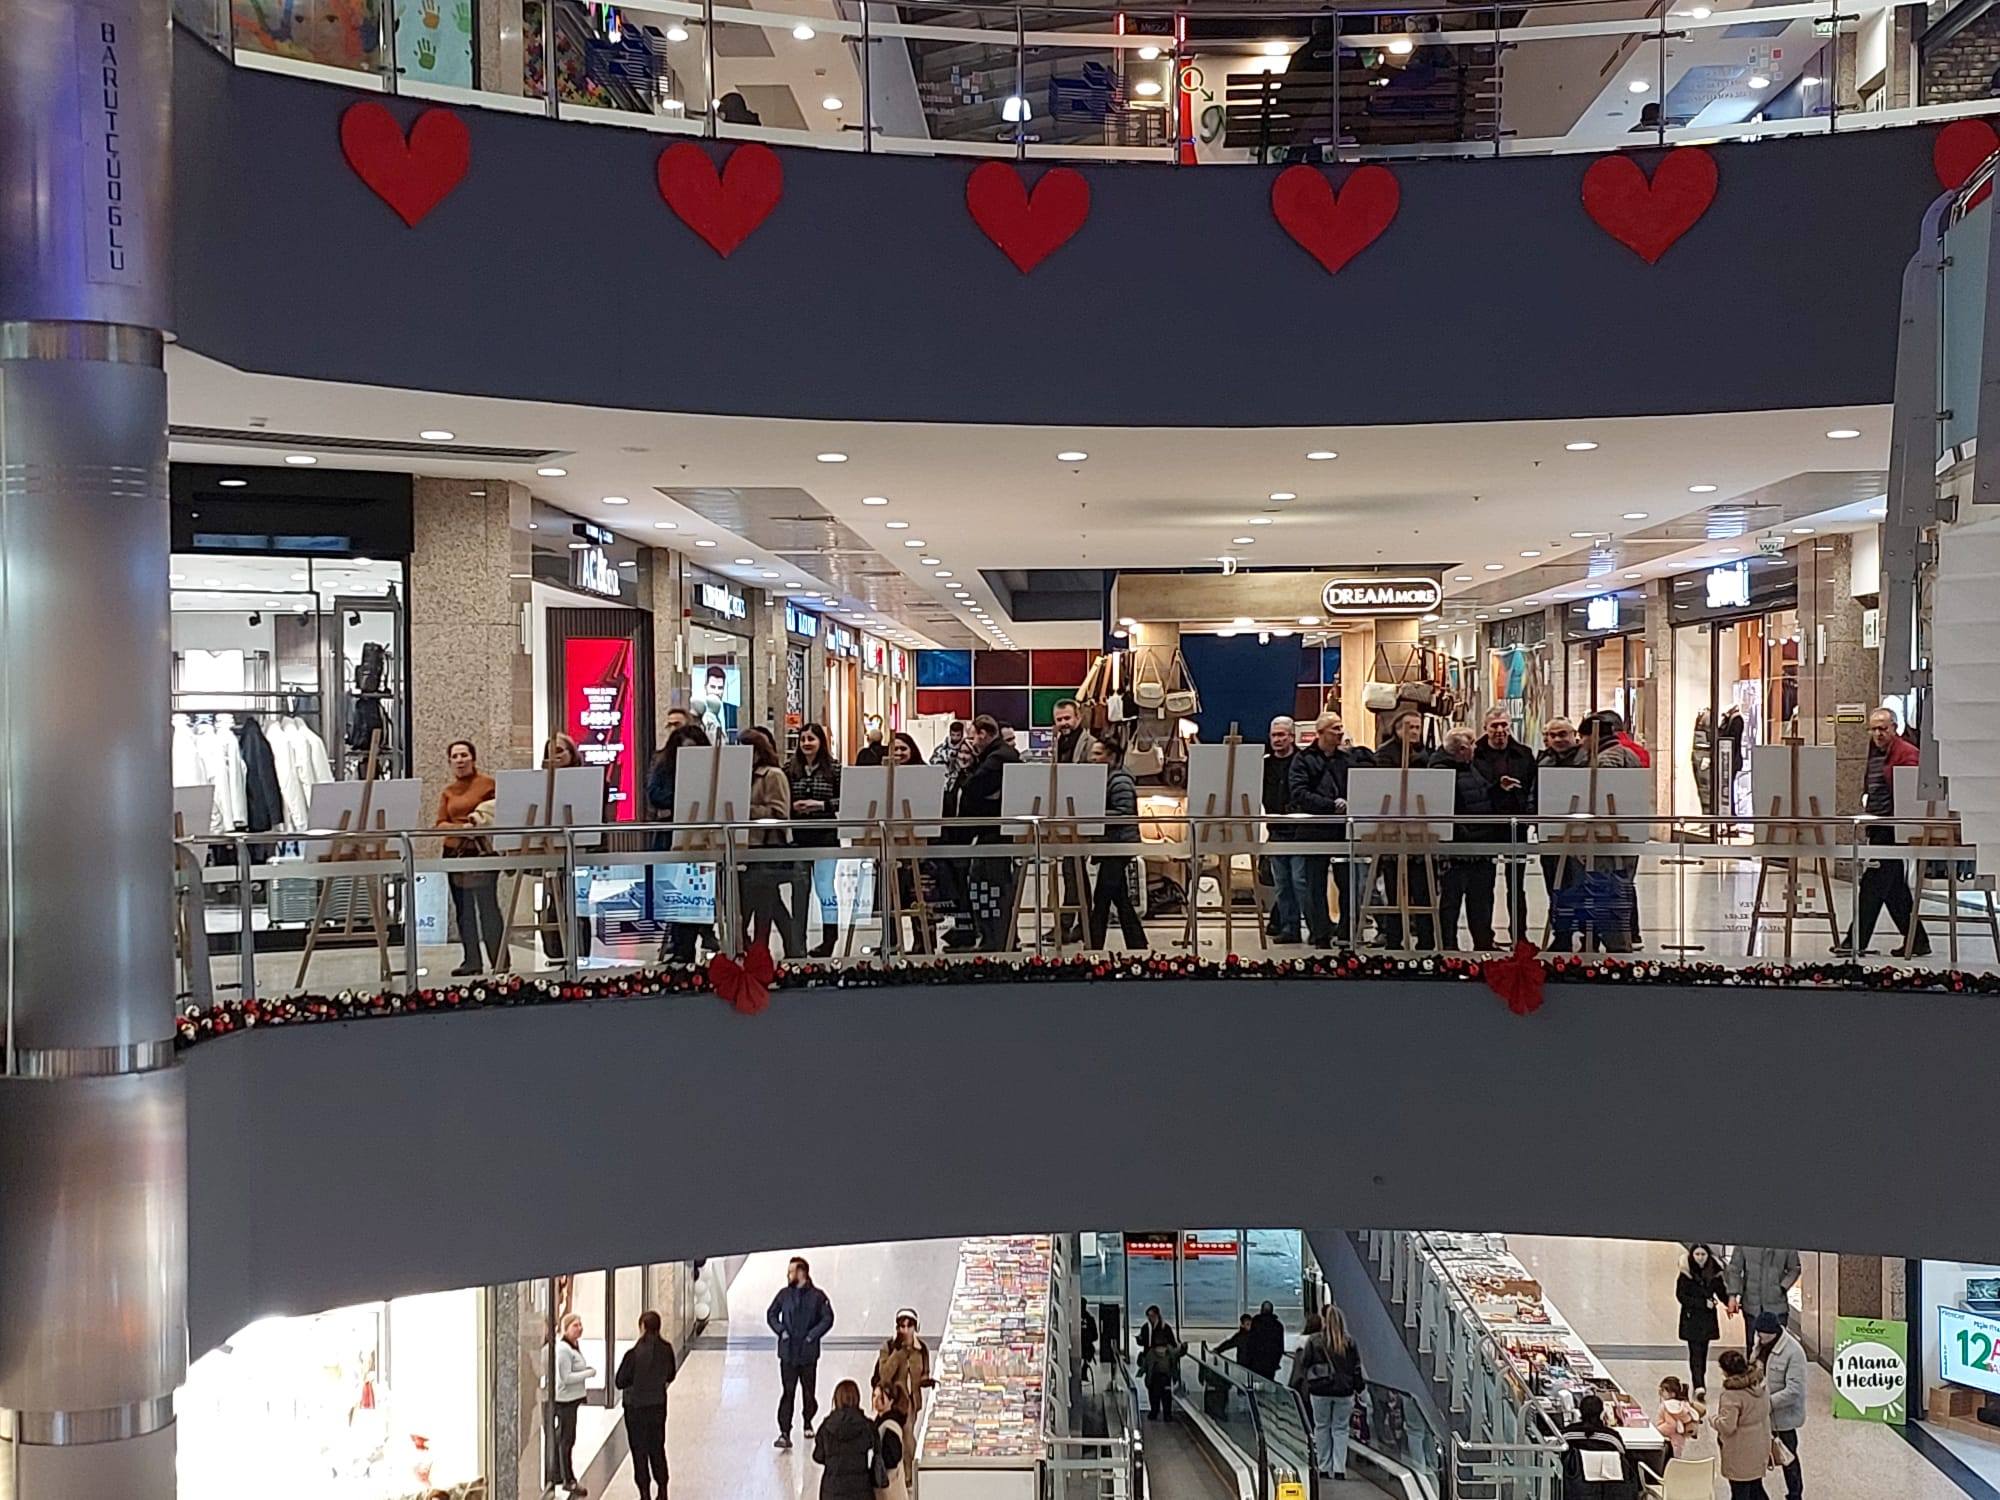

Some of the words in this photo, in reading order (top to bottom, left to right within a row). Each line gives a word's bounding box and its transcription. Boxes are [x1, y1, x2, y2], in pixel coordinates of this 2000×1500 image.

[1956, 1329, 1992, 1371] 12
[1837, 1358, 1844, 1370] 1
[1847, 1355, 1900, 1370] Alana
[1836, 1375, 1842, 1388] 1
[1846, 1372, 1905, 1391] Hediye
